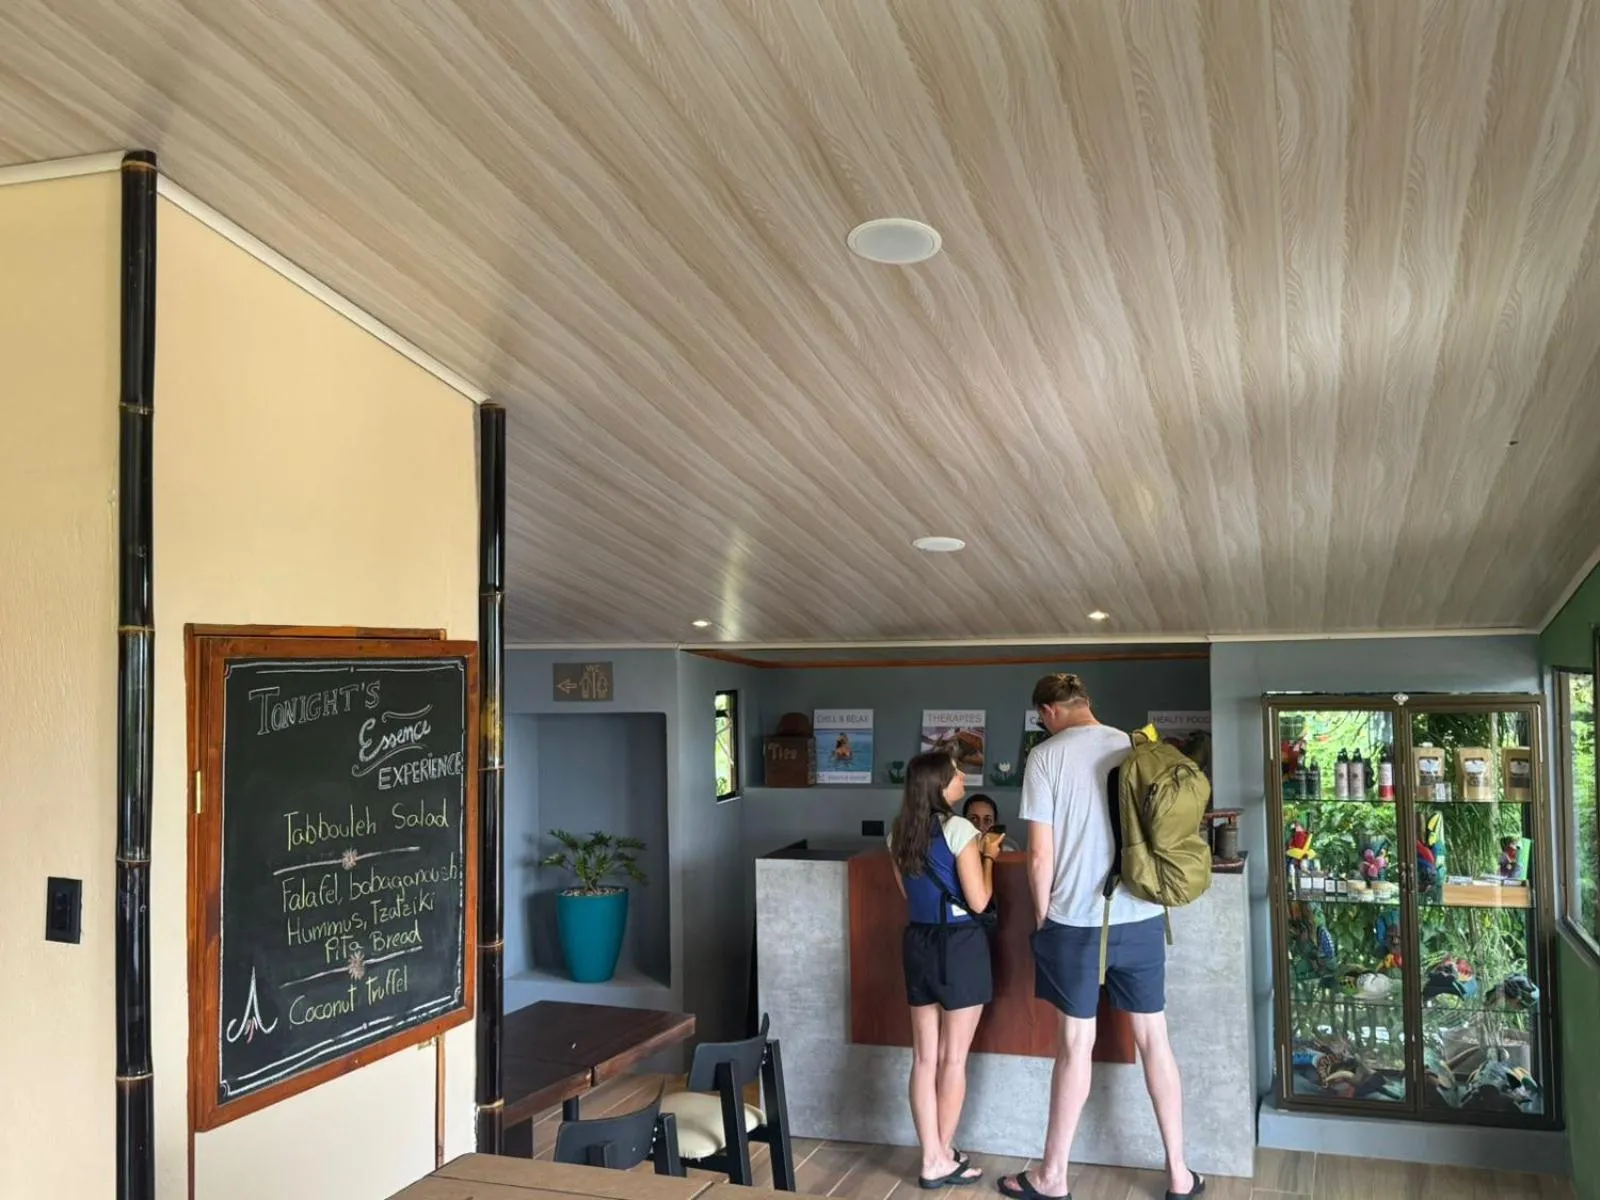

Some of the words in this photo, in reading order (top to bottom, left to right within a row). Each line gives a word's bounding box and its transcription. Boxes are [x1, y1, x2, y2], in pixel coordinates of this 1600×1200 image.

[248, 681, 381, 736] TONIGHT'S
[926, 713, 982, 724] THERAPIES
[359, 718, 432, 762] Essence
[377, 752, 464, 790] EXPERIENCE
[284, 805, 377, 851] Tabbouleh
[391, 798, 449, 830] Salad
[369, 918, 422, 951] Bread
[289, 984, 357, 1025] Coconut
[365, 964, 408, 1006] Truffel
